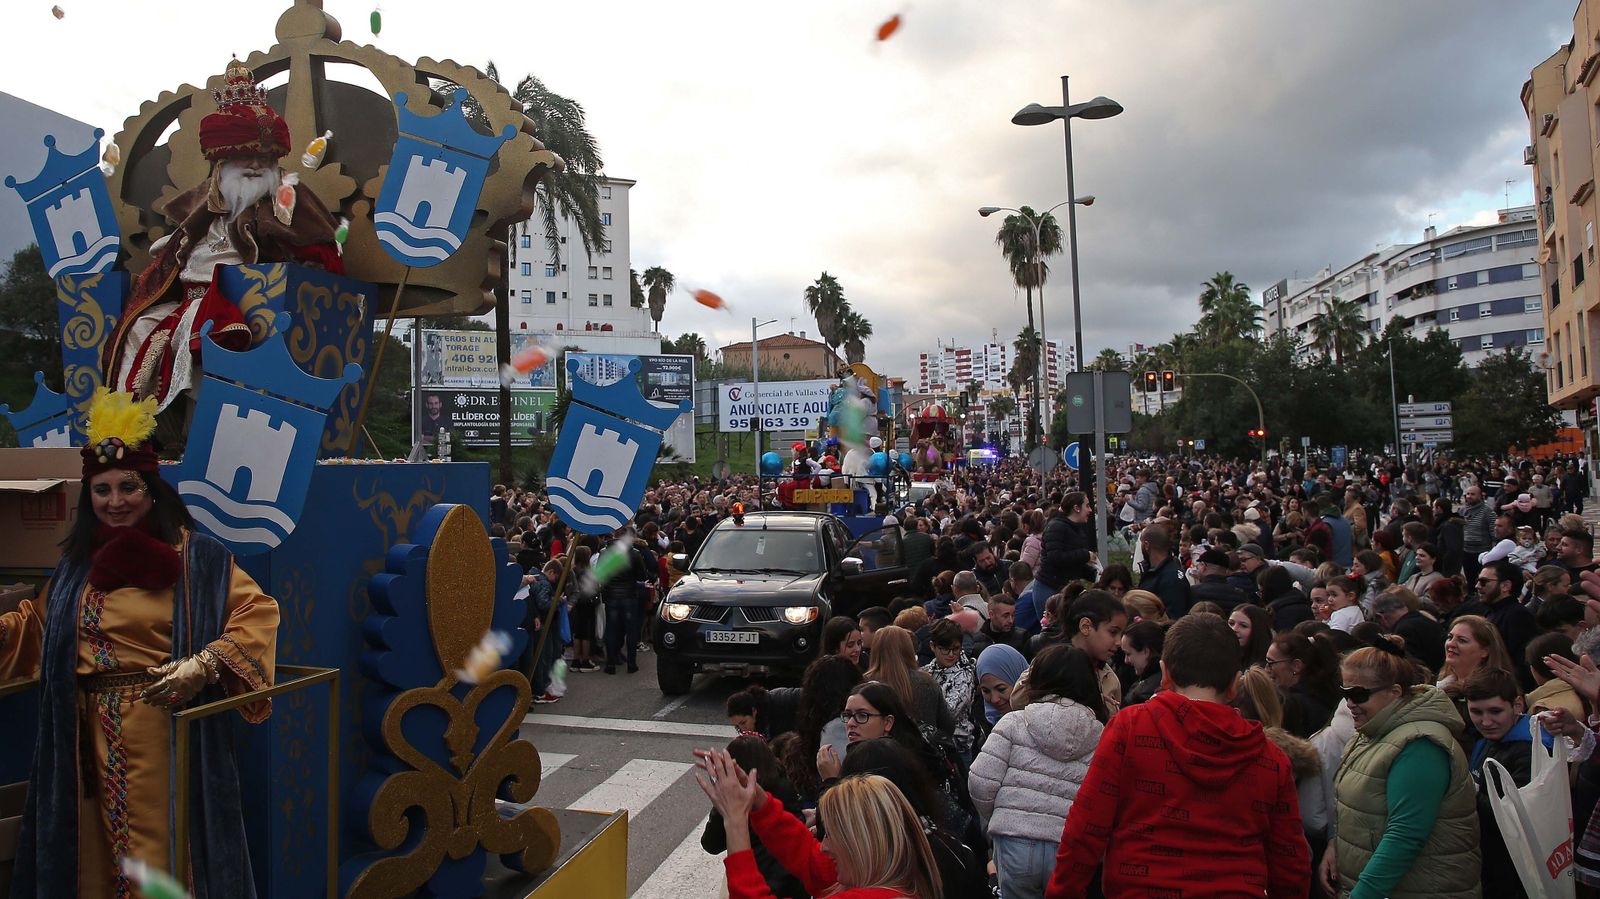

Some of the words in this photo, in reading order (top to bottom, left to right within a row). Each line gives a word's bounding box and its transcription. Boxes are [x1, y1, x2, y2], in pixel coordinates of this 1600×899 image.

[452, 354, 475, 363] 406
[730, 402, 799, 416] ANÚNCIATE
[803, 402, 828, 413] AQU
[451, 413, 460, 421] EL
[462, 411, 484, 421] LÍDER
[513, 411, 536, 421] LÍDER
[730, 418, 751, 429] 95
[765, 418, 784, 427] 63
[790, 417, 810, 427] 39
[713, 632, 736, 641] 3352
[739, 633, 757, 642] FJT
